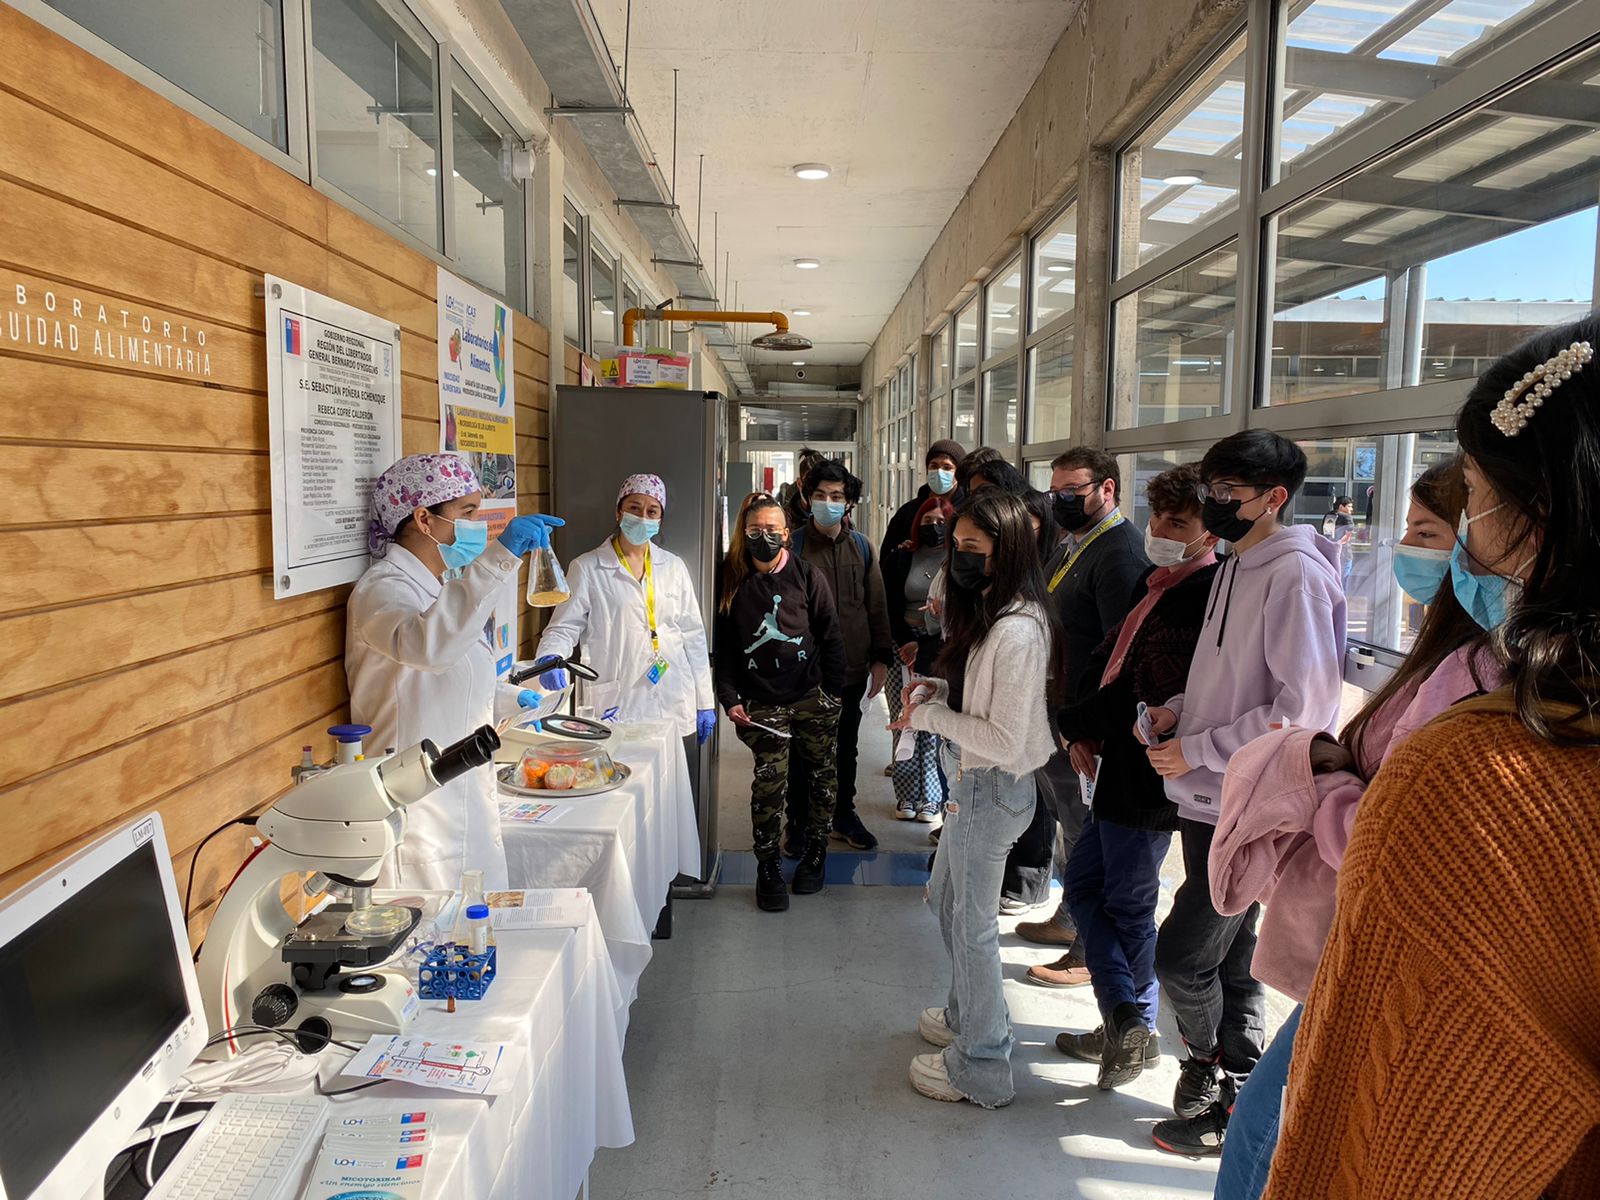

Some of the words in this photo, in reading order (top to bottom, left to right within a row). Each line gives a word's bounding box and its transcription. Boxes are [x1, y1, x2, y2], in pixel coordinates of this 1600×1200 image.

[0, 311, 79, 351] UIDAD
[94, 329, 211, 376] ALIMENTARIA
[336, 345, 345, 355] DEL
[345, 347, 372, 362] LIBERTADOR
[308, 349, 331, 364] GENERAL
[331, 355, 357, 369] BERNARDO
[311, 381, 341, 396] SEBASTIÁN
[342, 385, 360, 399] PIÑERA
[360, 390, 386, 405] ECHENIQUE
[318, 404, 336, 415] REBECA
[351, 408, 374, 420] CALDERÓN
